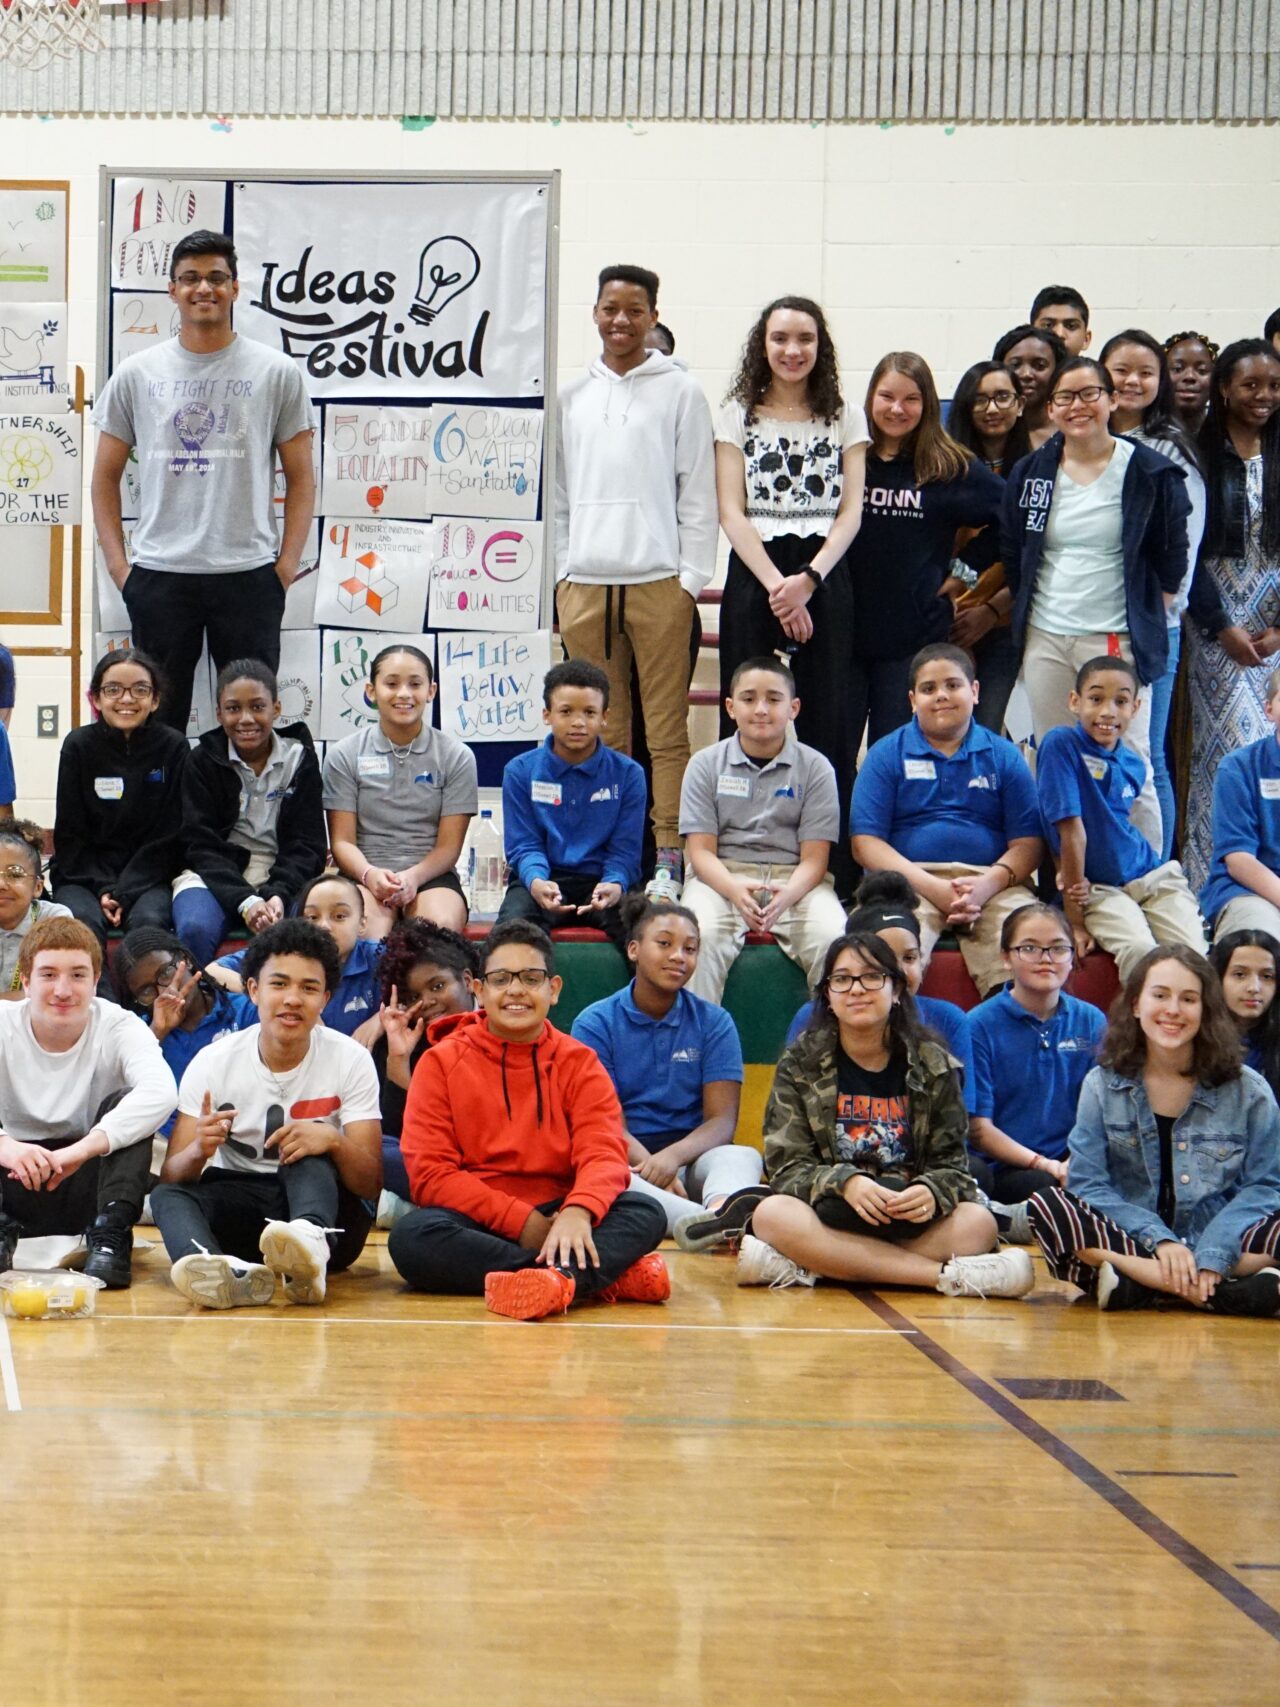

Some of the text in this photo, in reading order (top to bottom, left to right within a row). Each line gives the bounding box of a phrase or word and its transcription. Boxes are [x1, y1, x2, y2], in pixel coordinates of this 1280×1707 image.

[156, 185, 196, 225] NO
[119, 239, 178, 278] POVE
[250, 245, 396, 325] Ideas
[120, 299, 160, 336] 2
[280, 310, 490, 378] Festival
[148, 378, 253, 398] WE FIGHT FOR
[332, 415, 432, 454] 5 GENDER
[433, 409, 542, 463] 6 Clean
[337, 454, 430, 486] EQUALITY
[465, 440, 538, 470] WATER
[16, 477, 29, 488] 17
[5, 509, 60, 524] GOALS
[29, 493, 70, 510] THE
[892, 509, 924, 519] DIVING
[330, 524, 350, 558] 9
[438, 522, 476, 560] 10
[435, 590, 536, 613] INEQUALITIES
[443, 636, 473, 669] 14
[461, 672, 535, 702] Below
[456, 698, 534, 731] Water
